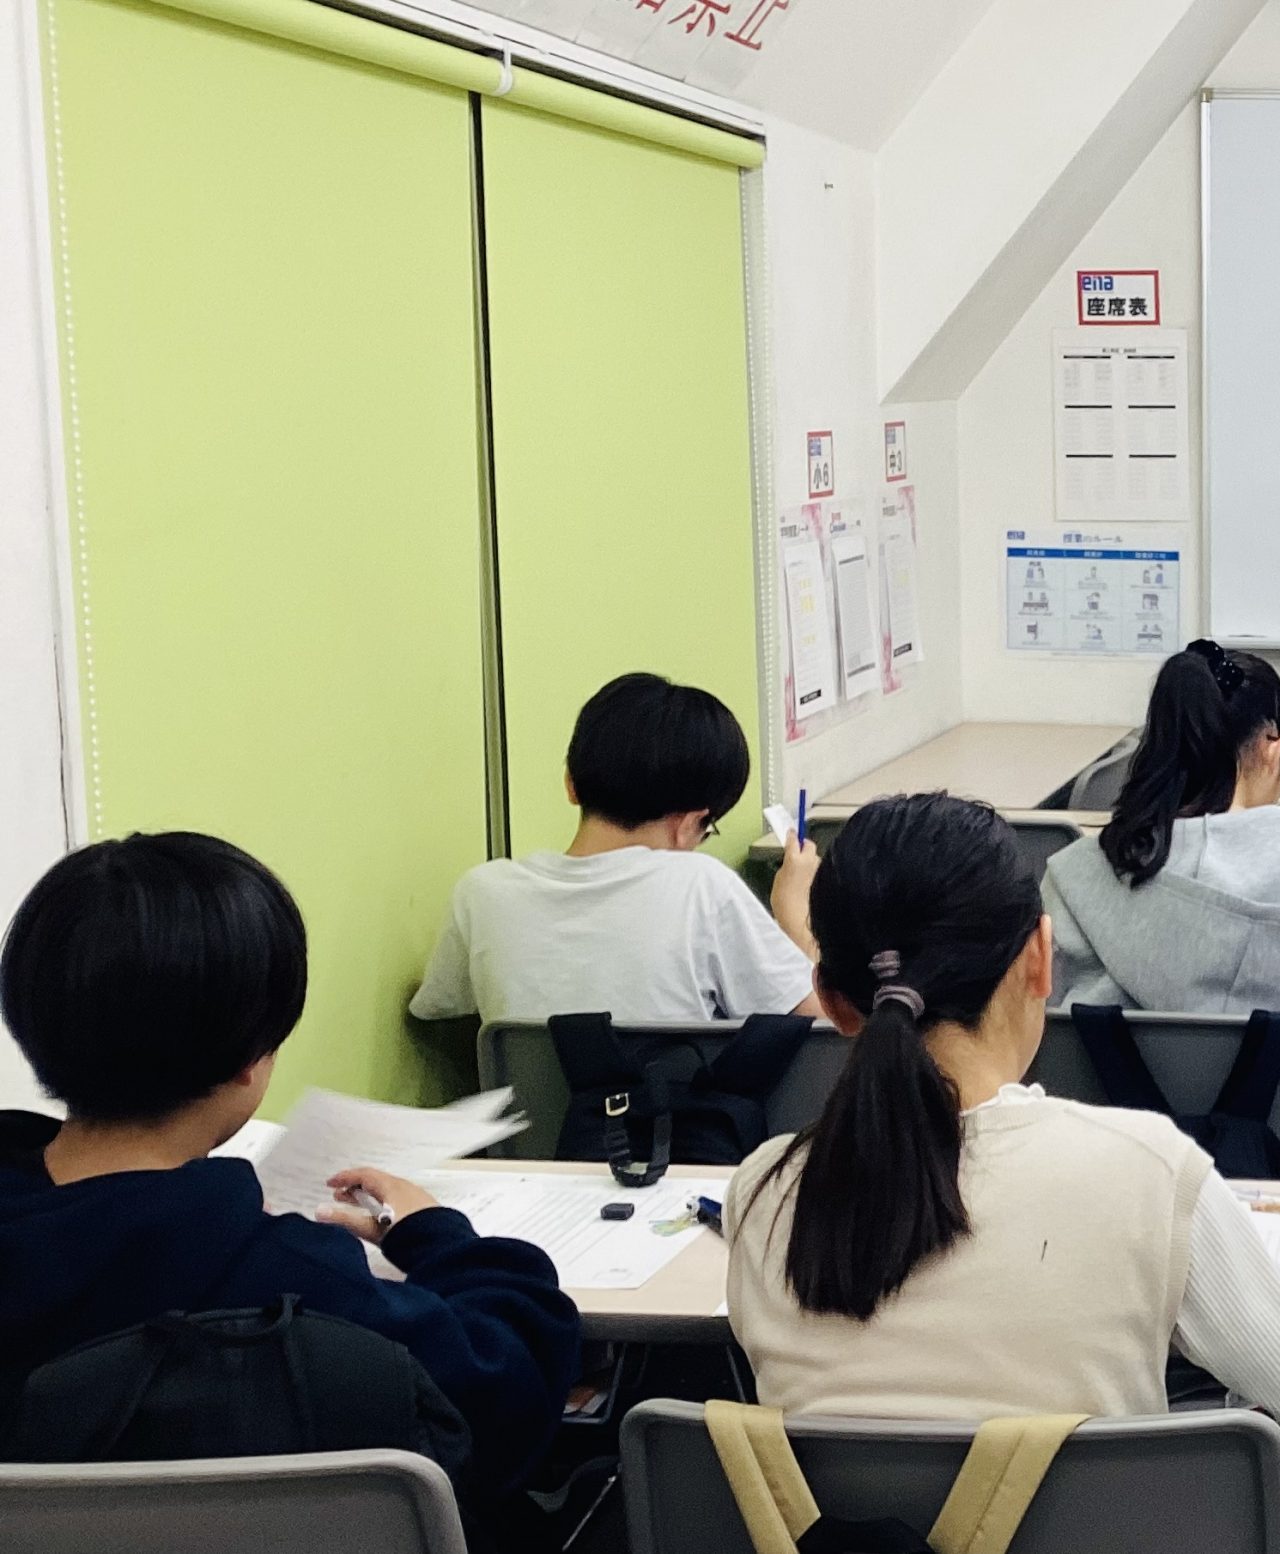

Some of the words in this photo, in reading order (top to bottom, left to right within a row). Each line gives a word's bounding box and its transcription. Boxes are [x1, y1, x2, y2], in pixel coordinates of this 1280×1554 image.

[1082, 276, 1113, 291] ena
[1087, 297, 1148, 317] 座席表
